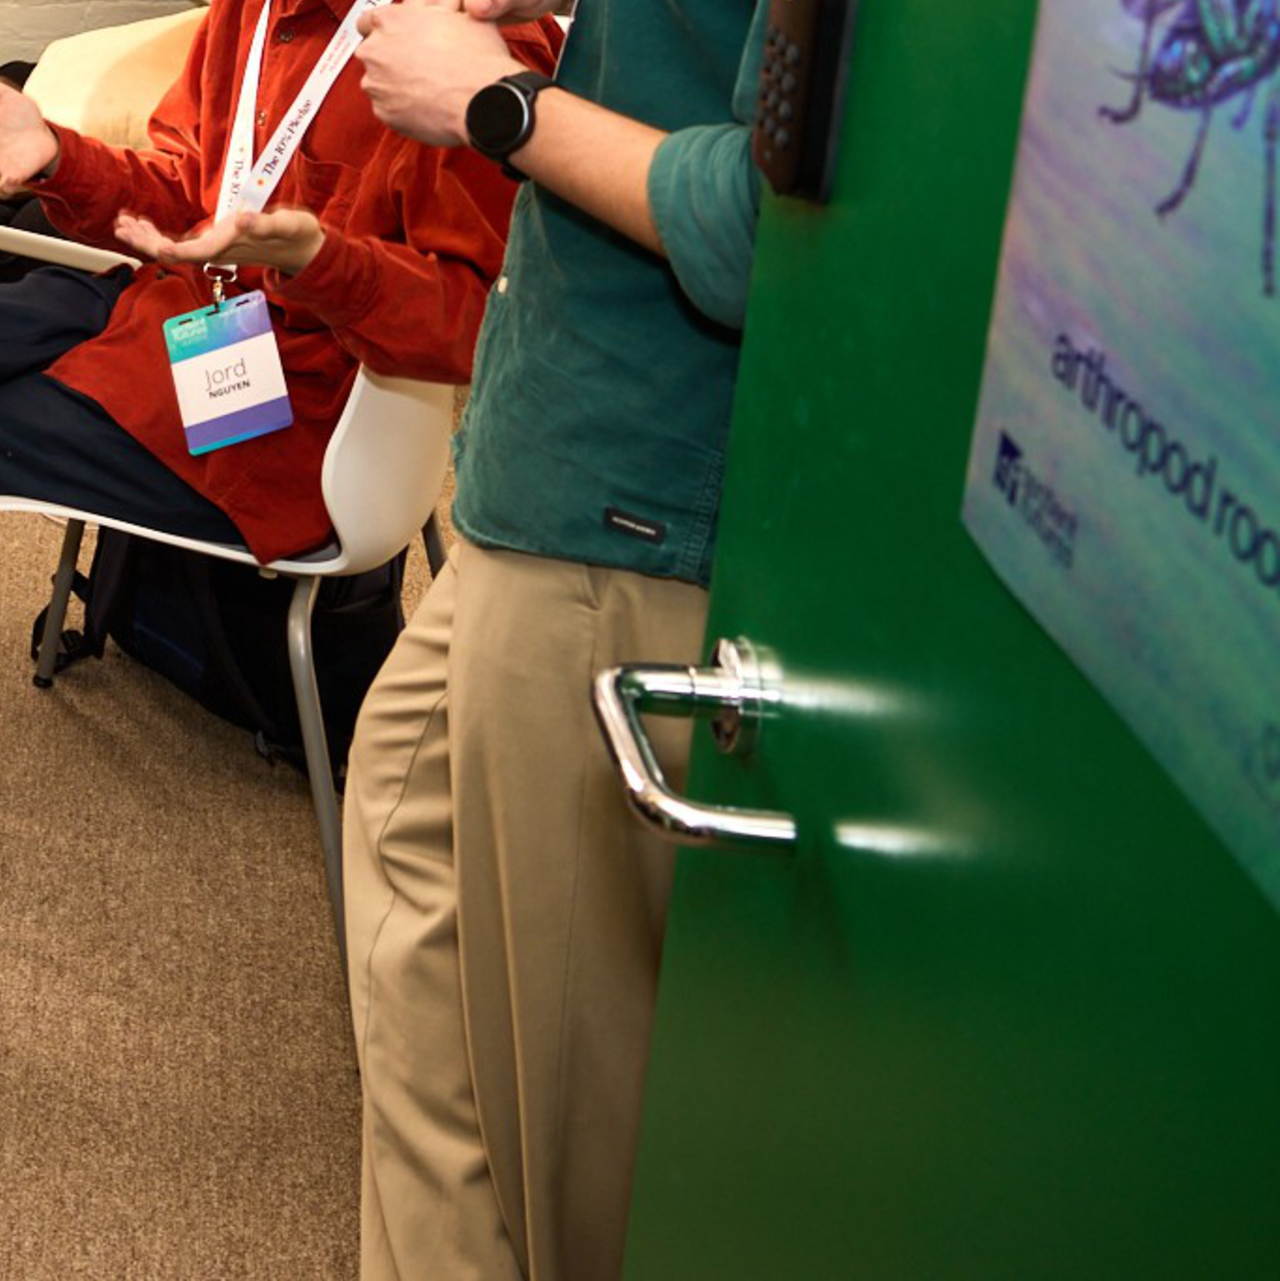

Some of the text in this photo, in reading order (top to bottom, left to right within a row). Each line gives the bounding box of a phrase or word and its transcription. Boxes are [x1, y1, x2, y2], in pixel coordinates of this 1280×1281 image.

[261, 155, 280, 176] The
[204, 357, 247, 393] Jord
[208, 379, 251, 399] NGUYEN
[1051, 332, 1217, 524] arthropod
[1213, 488, 1280, 588] roo
